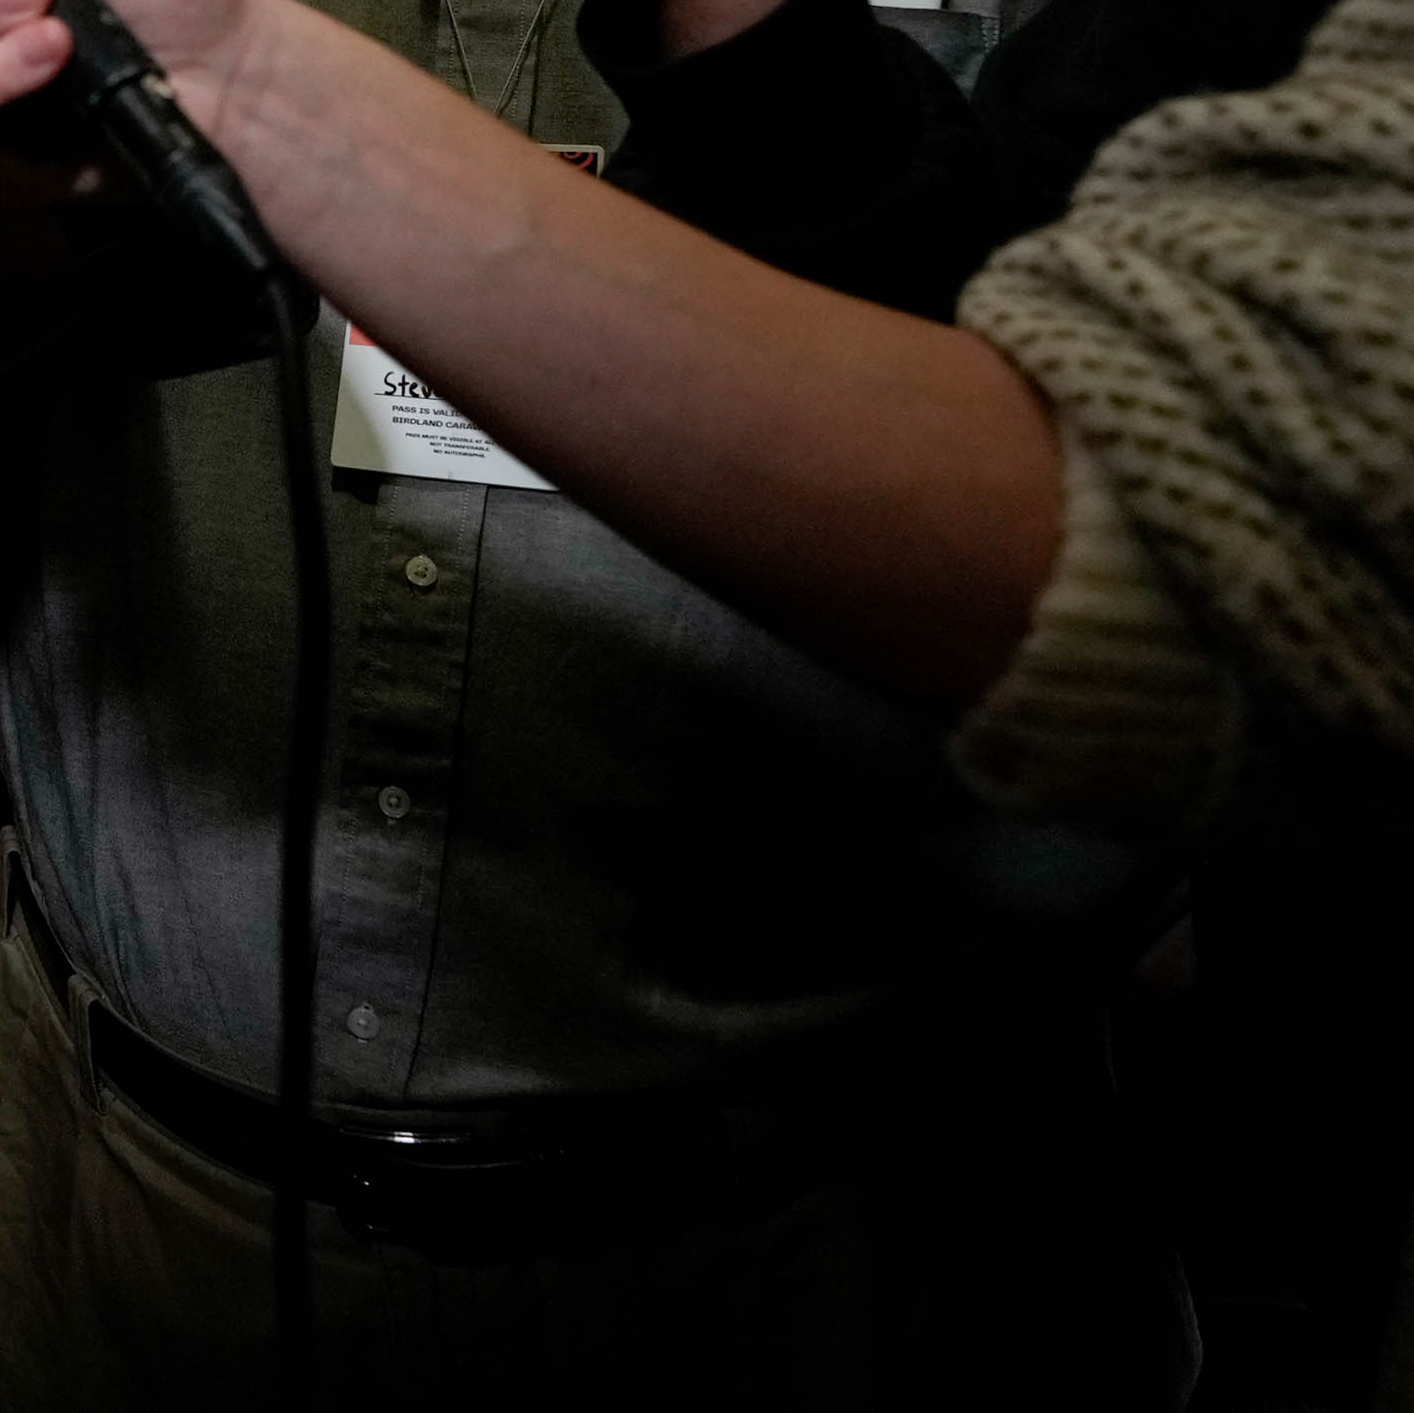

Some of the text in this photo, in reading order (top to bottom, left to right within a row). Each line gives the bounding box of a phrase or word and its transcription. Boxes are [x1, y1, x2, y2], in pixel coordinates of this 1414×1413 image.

[392, 405, 417, 414] PASS
[419, 407, 430, 415] IS
[392, 416, 444, 428] BIRDLAND
